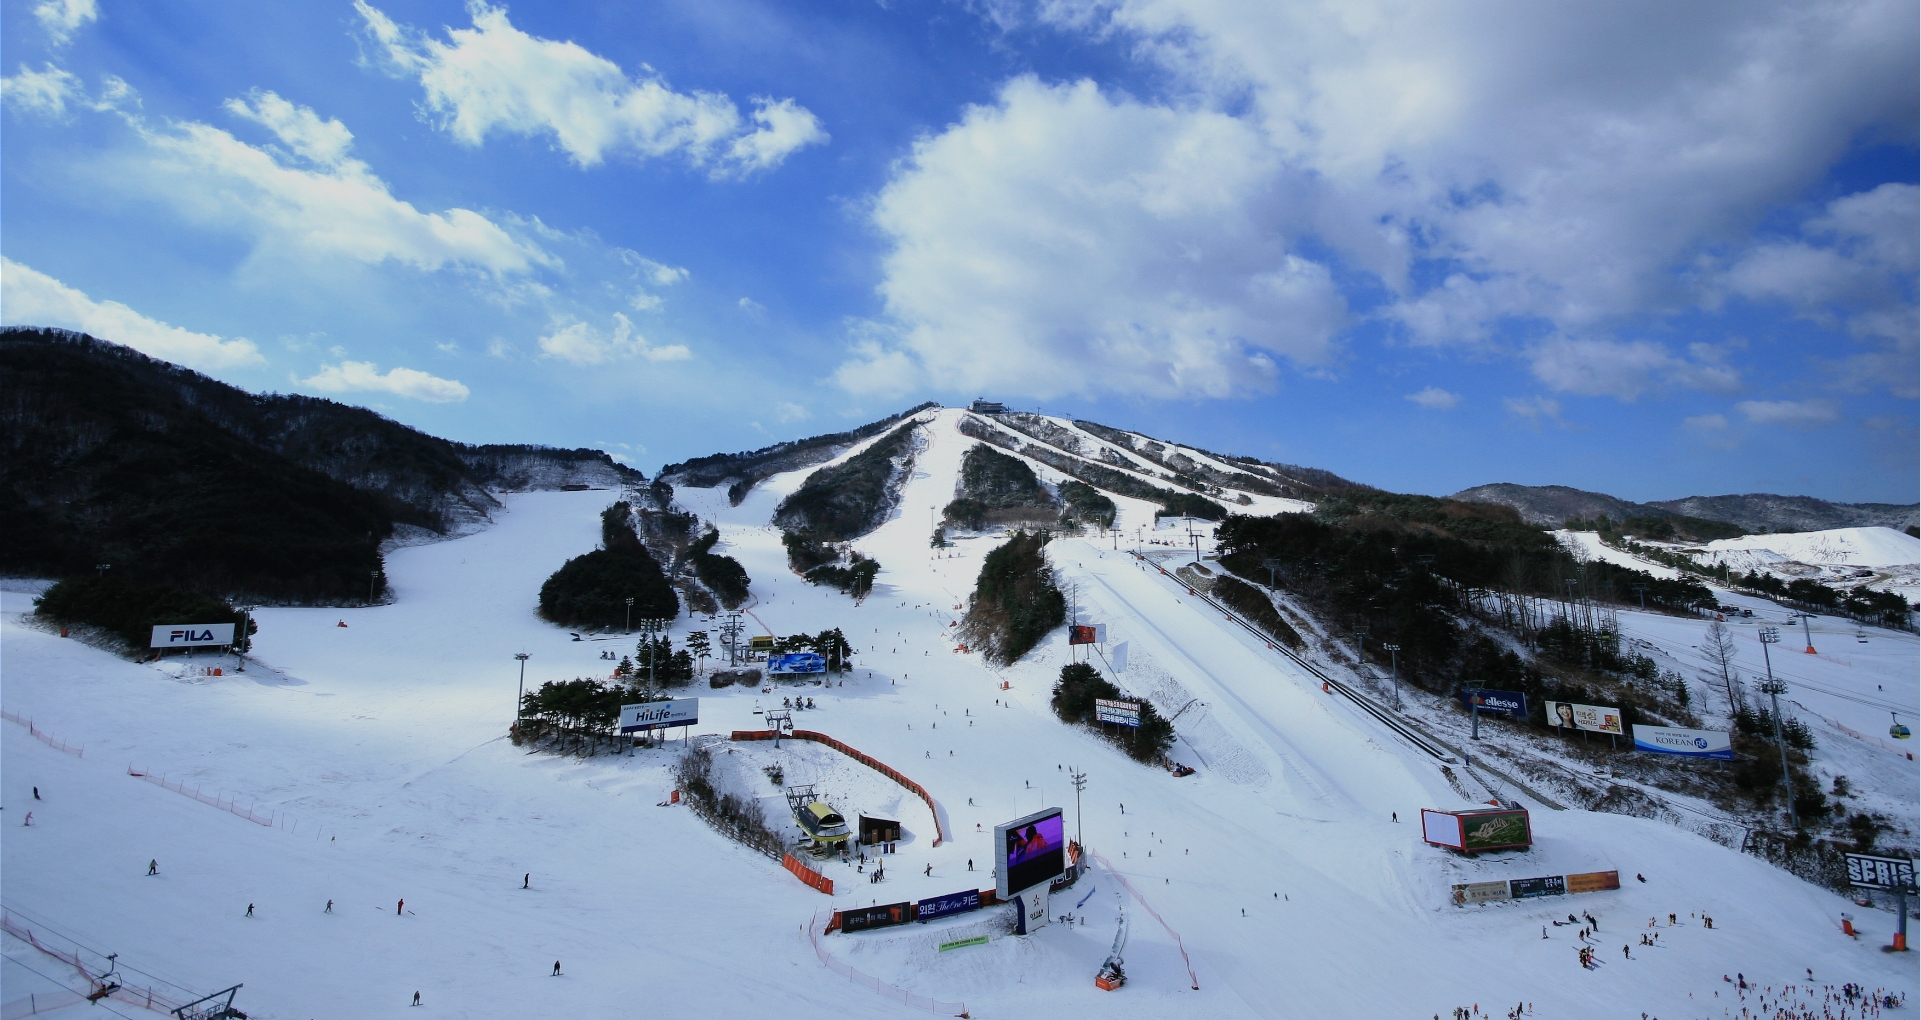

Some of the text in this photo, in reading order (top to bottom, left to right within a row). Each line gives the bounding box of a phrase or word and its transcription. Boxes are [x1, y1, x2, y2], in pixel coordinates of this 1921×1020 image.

[170, 629, 214, 642] FILA
[1485, 696, 1518, 709] ellesse
[636, 708, 671, 721] HiLife
[1655, 736, 1694, 747] KOREAN
[919, 903, 936, 915] 외환
[962, 894, 978, 906] 카드
